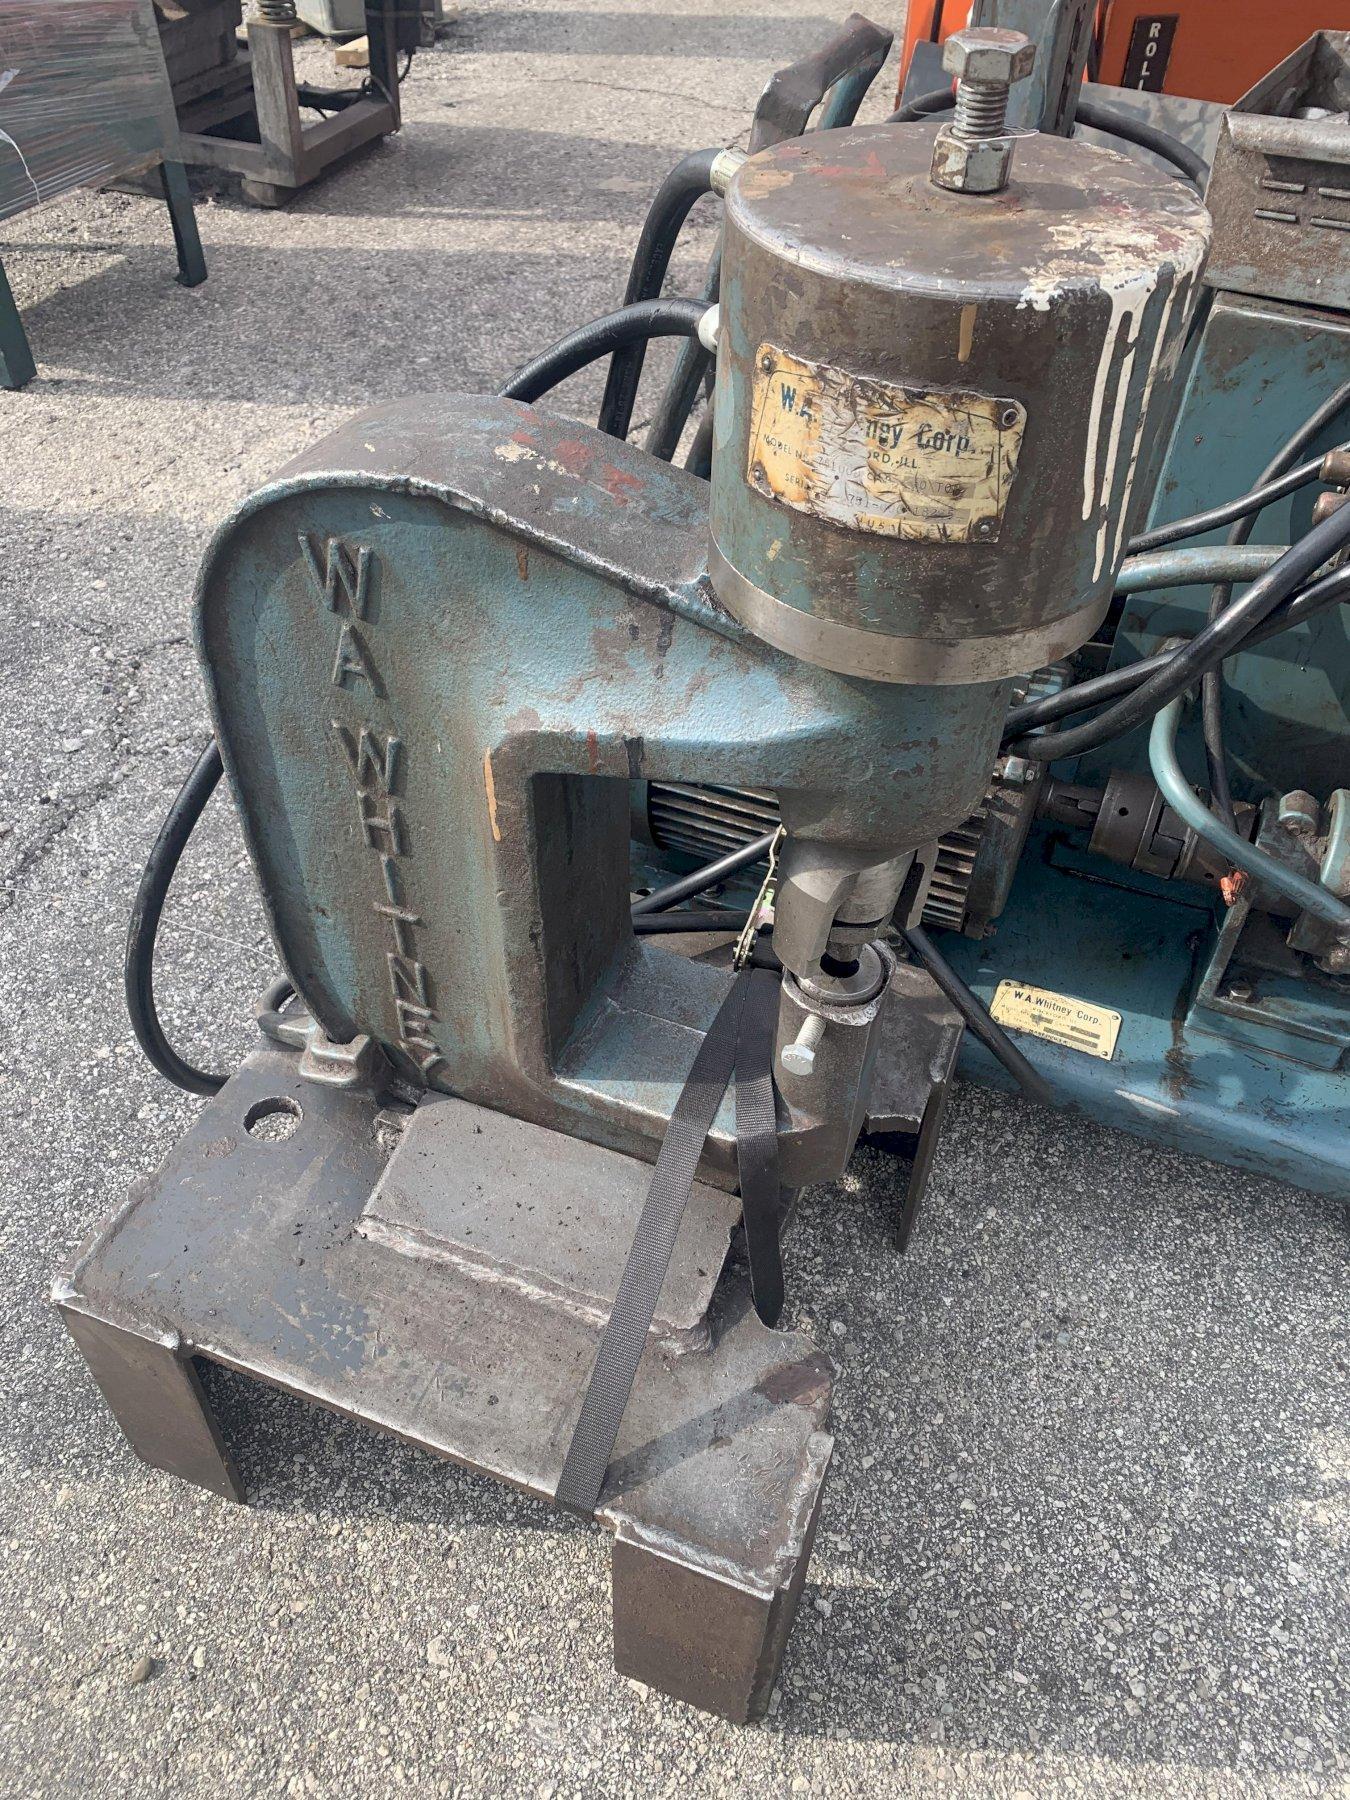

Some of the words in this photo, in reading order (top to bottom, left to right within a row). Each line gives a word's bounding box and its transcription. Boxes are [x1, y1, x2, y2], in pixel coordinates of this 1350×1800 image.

[763, 434, 792, 455] MODEL
[331, 718, 443, 1082] WHITNEY
[1036, 995, 1072, 1017] Whitney
[1077, 1010, 1102, 1025] Corp.
